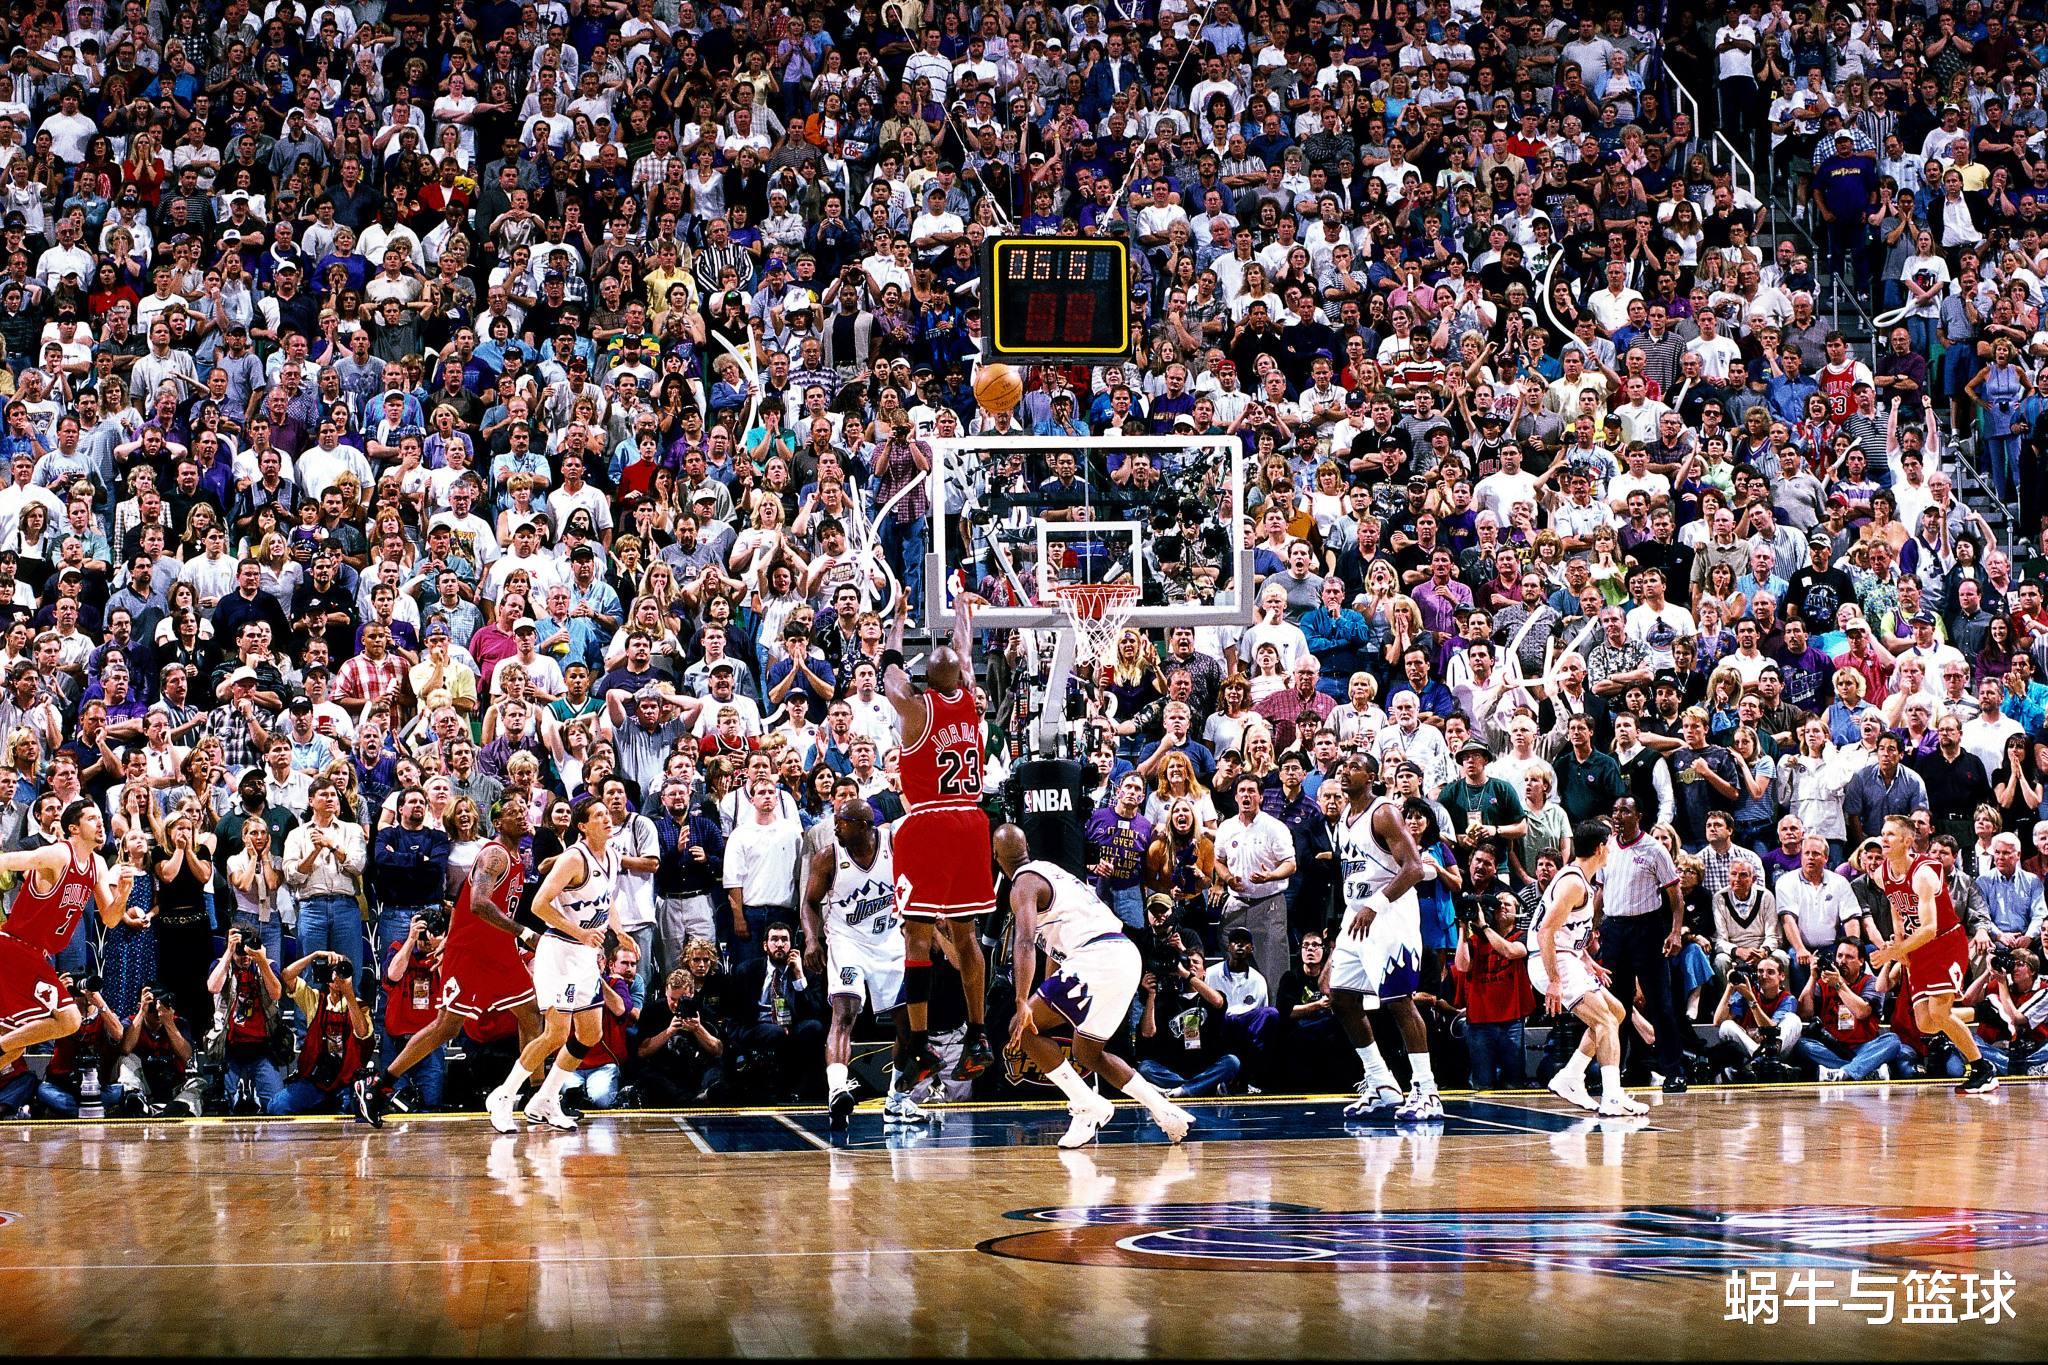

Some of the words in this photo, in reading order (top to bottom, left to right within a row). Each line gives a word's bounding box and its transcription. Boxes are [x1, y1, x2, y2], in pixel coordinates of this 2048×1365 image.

[1478, 459, 1500, 479] BULL
[931, 722, 979, 754] JORDA
[936, 746, 984, 796] 23
[1032, 788, 1073, 812] NBA
[1113, 836, 1134, 848] OVER
[1124, 849, 1141, 861] THE
[1346, 881, 1373, 900] 32
[55, 908, 79, 936] 7
